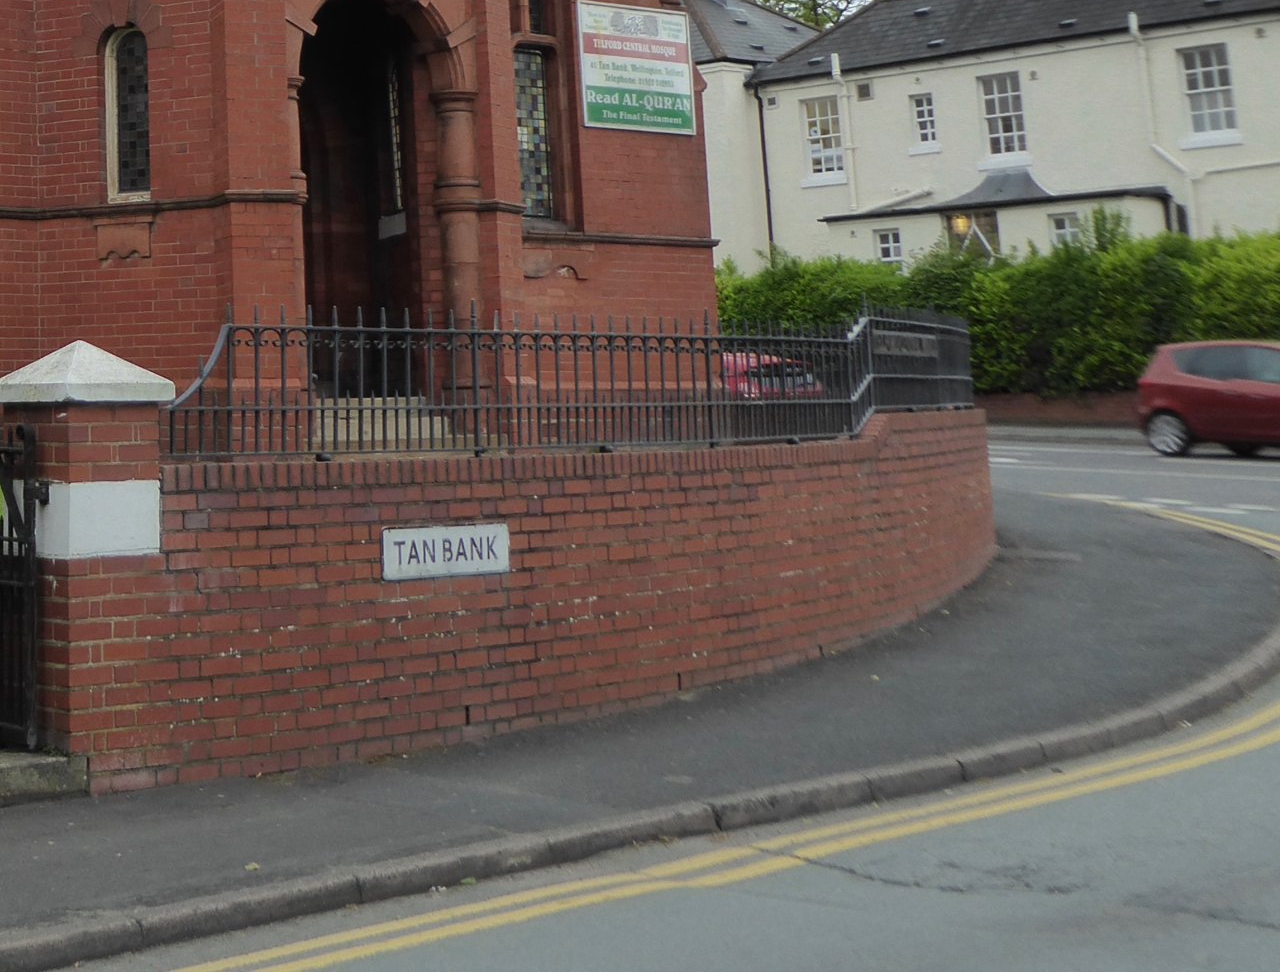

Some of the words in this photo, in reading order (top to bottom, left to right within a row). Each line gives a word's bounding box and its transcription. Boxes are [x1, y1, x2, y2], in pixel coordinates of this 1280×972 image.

[593, 38, 622, 50] TELFORD
[622, 42, 651, 53] CENTRAL
[651, 45, 676, 57] MOSQUE
[598, 60, 610, 70] Tan
[586, 90, 619, 105] Read
[622, 93, 691, 114] AL-QUR'AN
[602, 109, 618, 119] The
[619, 111, 641, 121] Final
[642, 112, 682, 124] Testament
[393, 538, 436, 565] TAN
[442, 535, 498, 563] BANK
